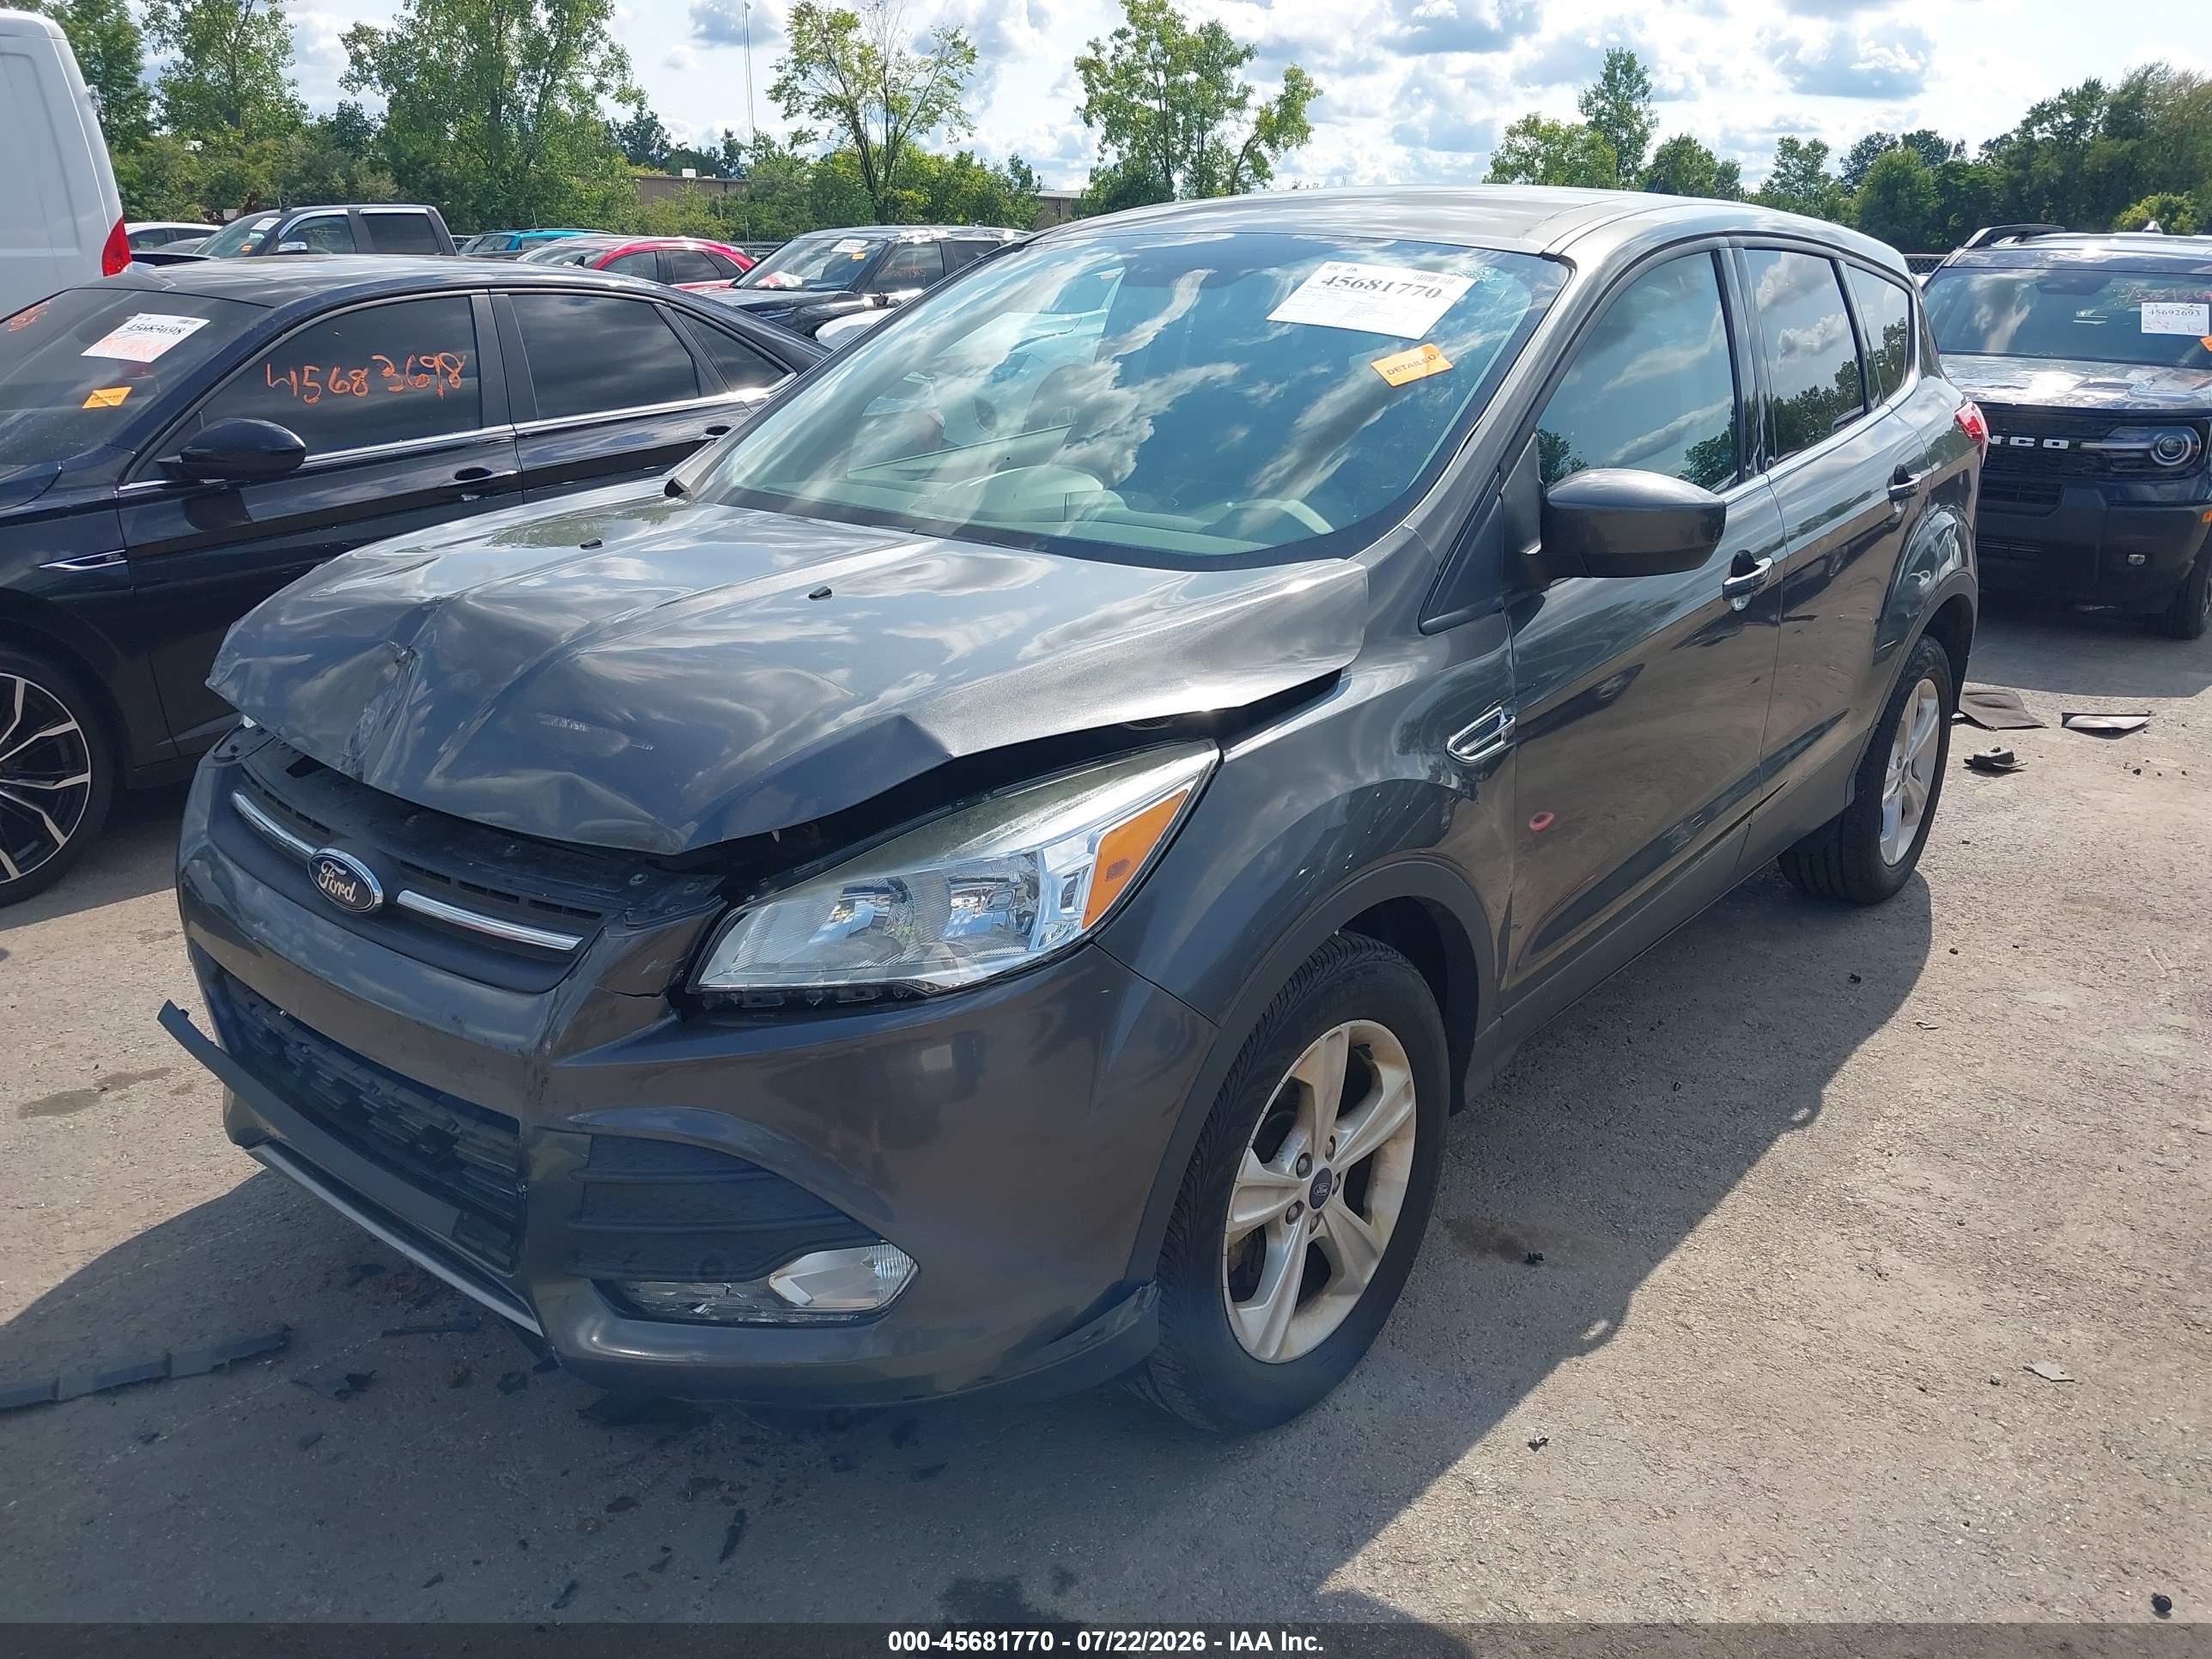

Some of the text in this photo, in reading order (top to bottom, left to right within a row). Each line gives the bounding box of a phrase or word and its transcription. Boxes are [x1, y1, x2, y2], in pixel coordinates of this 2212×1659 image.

[1321, 275, 1443, 299] 45681770
[2148, 309, 2201, 318] 45692693
[265, 351, 467, 405] 45683698
[318, 860, 357, 903] Ford
